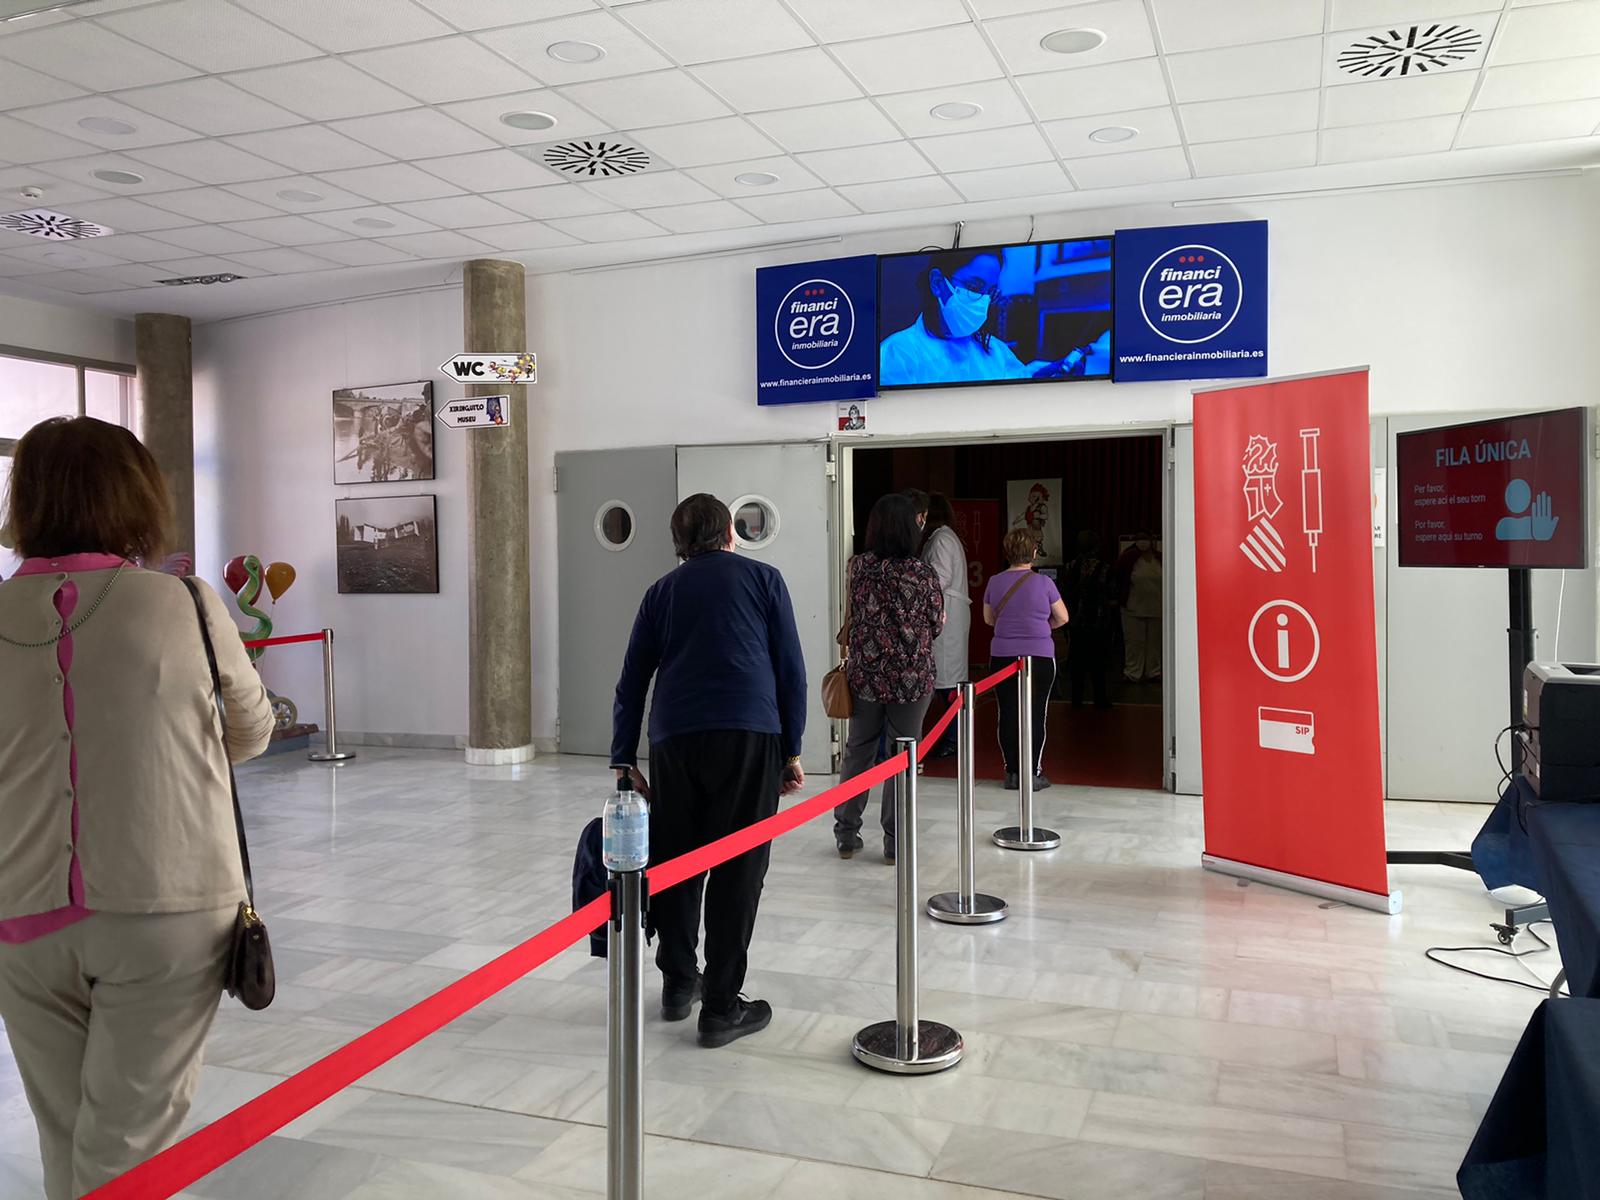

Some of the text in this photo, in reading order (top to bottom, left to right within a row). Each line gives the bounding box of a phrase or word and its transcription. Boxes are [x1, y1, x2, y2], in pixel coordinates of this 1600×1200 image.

[1160, 266, 1221, 281] financi
[1158, 282, 1223, 309] era
[790, 298, 838, 313] financi
[1161, 311, 1221, 322] inmobiliaria
[789, 313, 840, 339] era
[791, 339, 838, 350] inmobiliaria
[1119, 349, 1264, 363] www.financierainmobiliaria.es
[453, 361, 485, 376] WC
[760, 373, 871, 388] www.financierainmobiliaria.es
[449, 404, 484, 413] XIRINGUITO
[1436, 438, 1532, 467] FILA ÚNICA
[1414, 484, 1425, 493] Per
[1414, 497, 1436, 507] espere
[1449, 494, 1456, 504] el
[1457, 495, 1469, 504] seu
[1470, 494, 1486, 503] torn
[1415, 520, 1426, 529] Por
[1415, 533, 1437, 543] espere
[1454, 533, 1463, 541] su
[1463, 532, 1483, 541] turno
[1295, 726, 1310, 736] SIP
